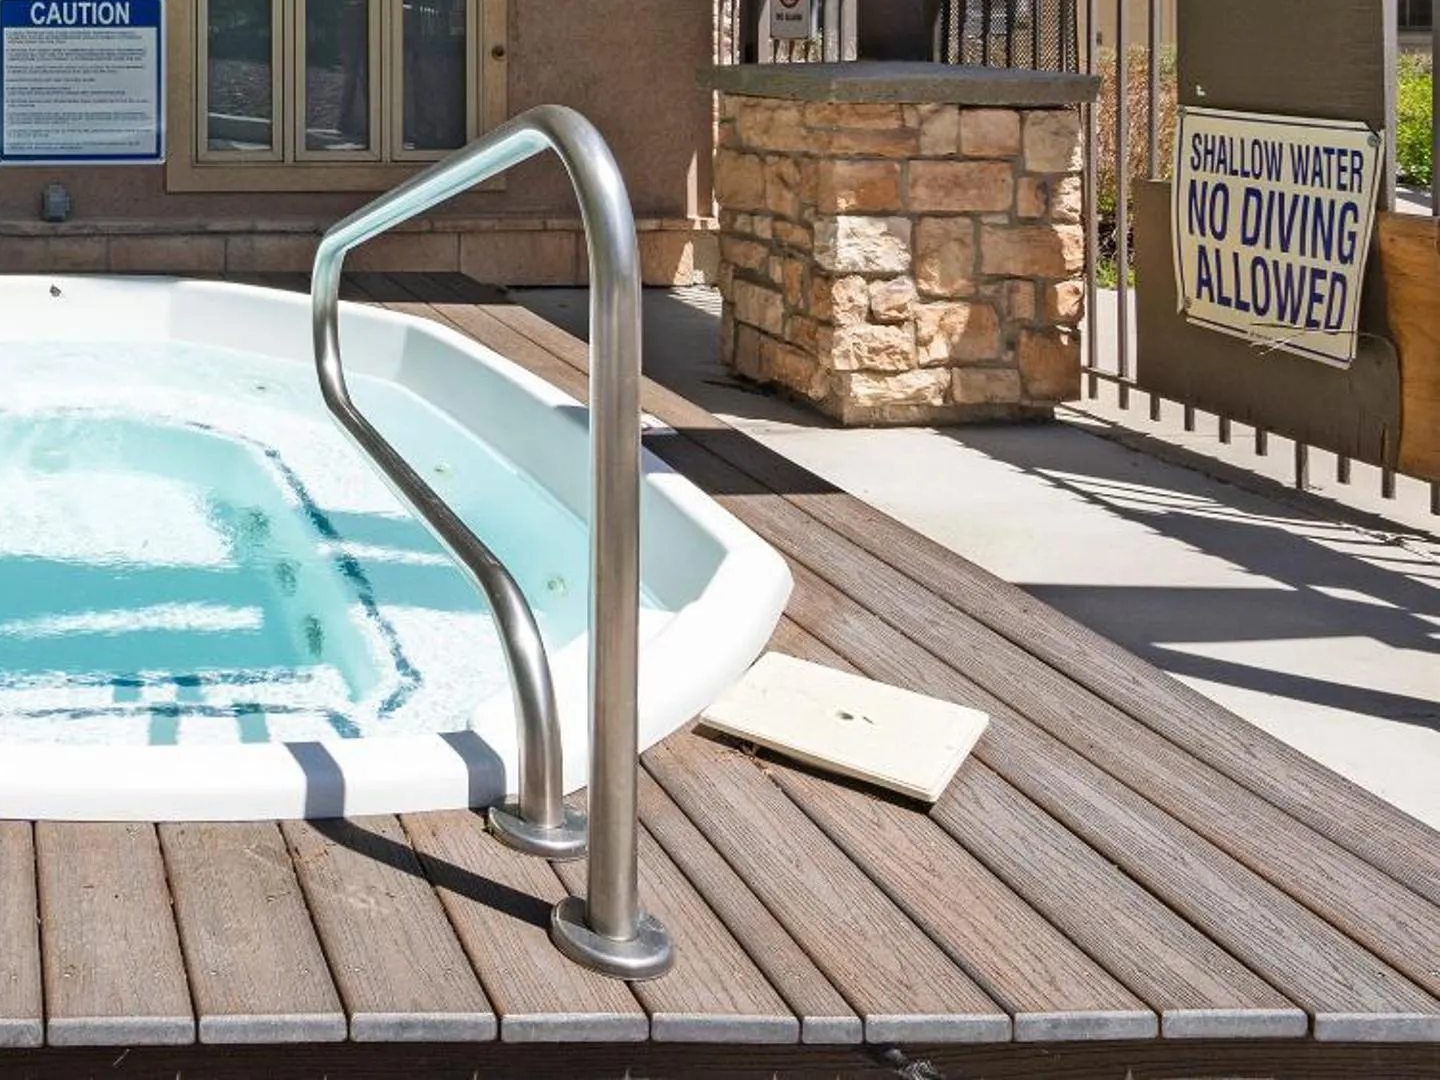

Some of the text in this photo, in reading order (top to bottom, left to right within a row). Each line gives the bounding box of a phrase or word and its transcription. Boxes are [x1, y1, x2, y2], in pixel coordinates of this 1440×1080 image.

[30, 1, 130, 25] CAUTION
[1190, 132, 1364, 194] SHALLOW WATER
[1188, 179, 1360, 265] NO DIVING
[1196, 245, 1349, 336] ALLOWED
